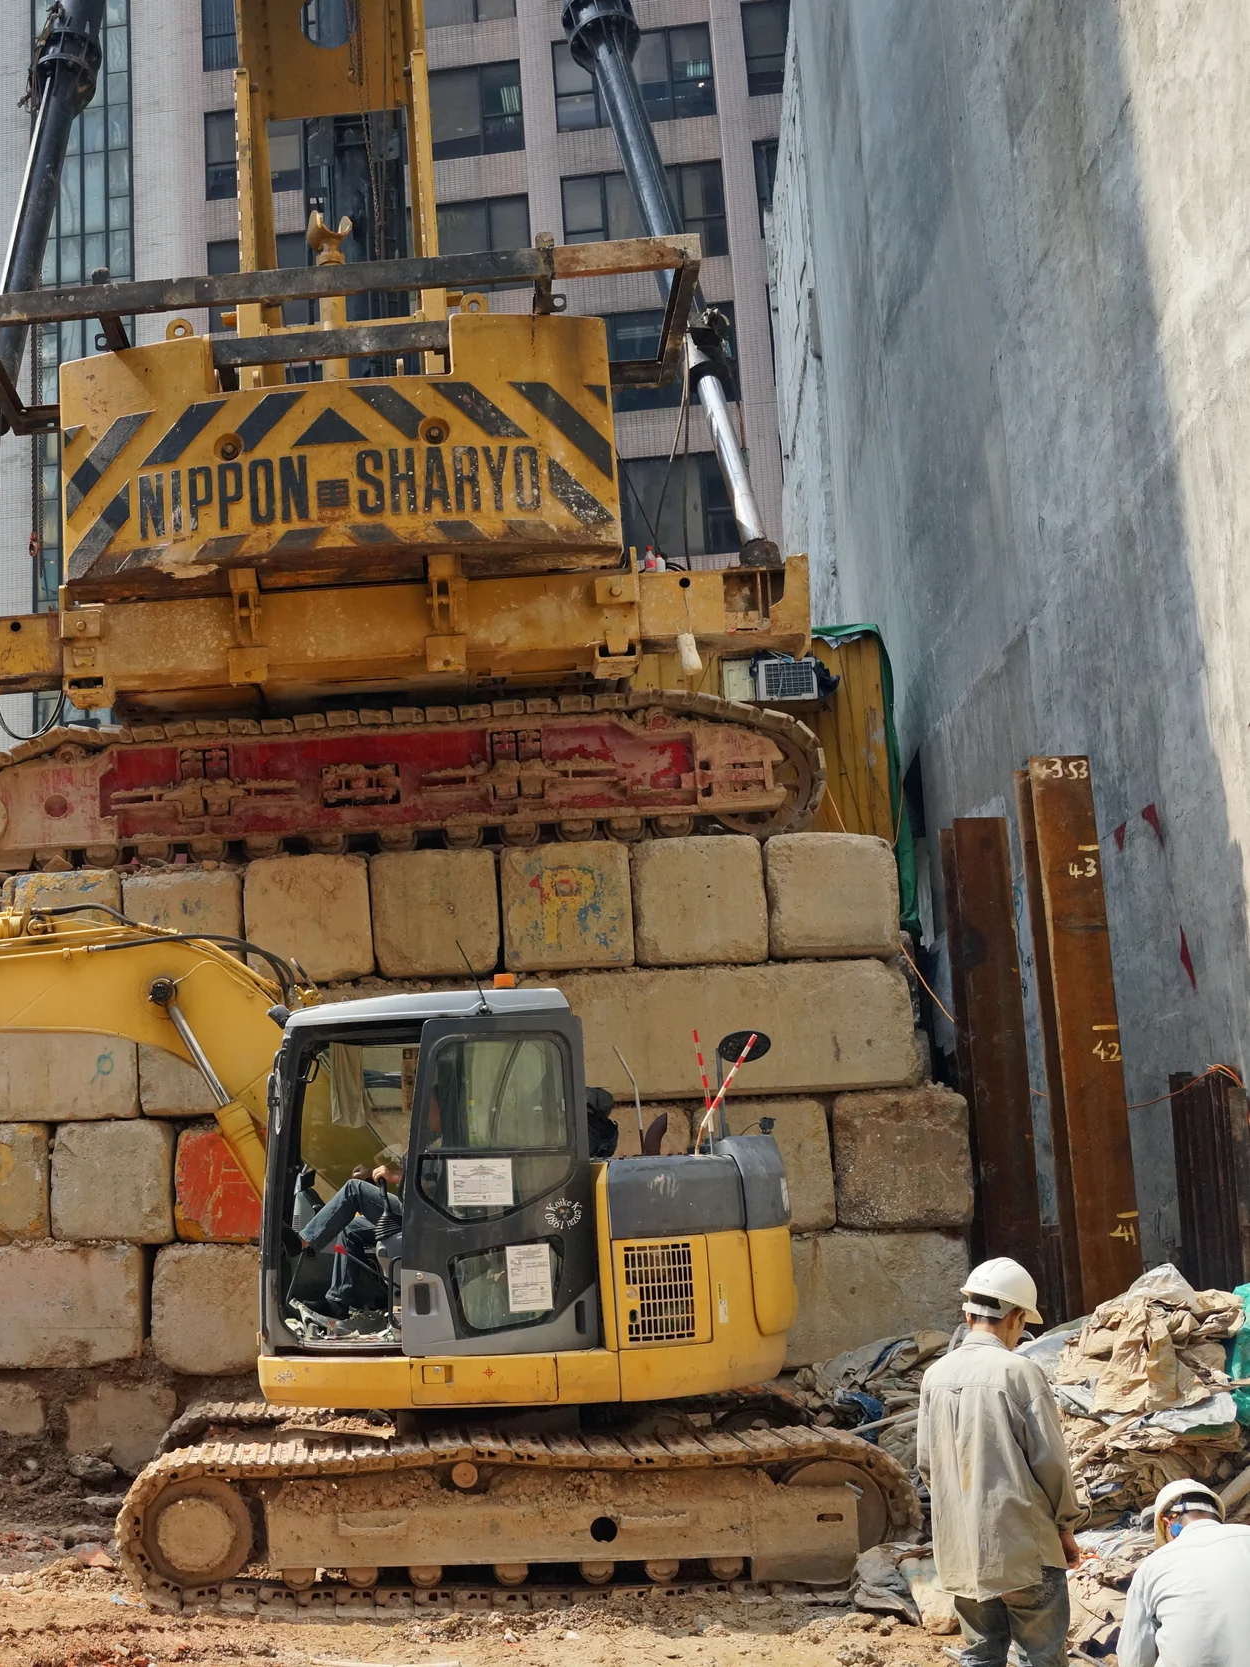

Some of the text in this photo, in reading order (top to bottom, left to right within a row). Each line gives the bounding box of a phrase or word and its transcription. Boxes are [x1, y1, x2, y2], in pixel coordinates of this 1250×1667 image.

[137, 454, 310, 541] NIPPON
[356, 445, 542, 515] SHARYO
[1068, 857, 1097, 879] 43
[1092, 1040, 1122, 1062] 42
[544, 1197, 583, 1230] Koike Kenzai 1980
[1109, 1223, 1138, 1246] 41
